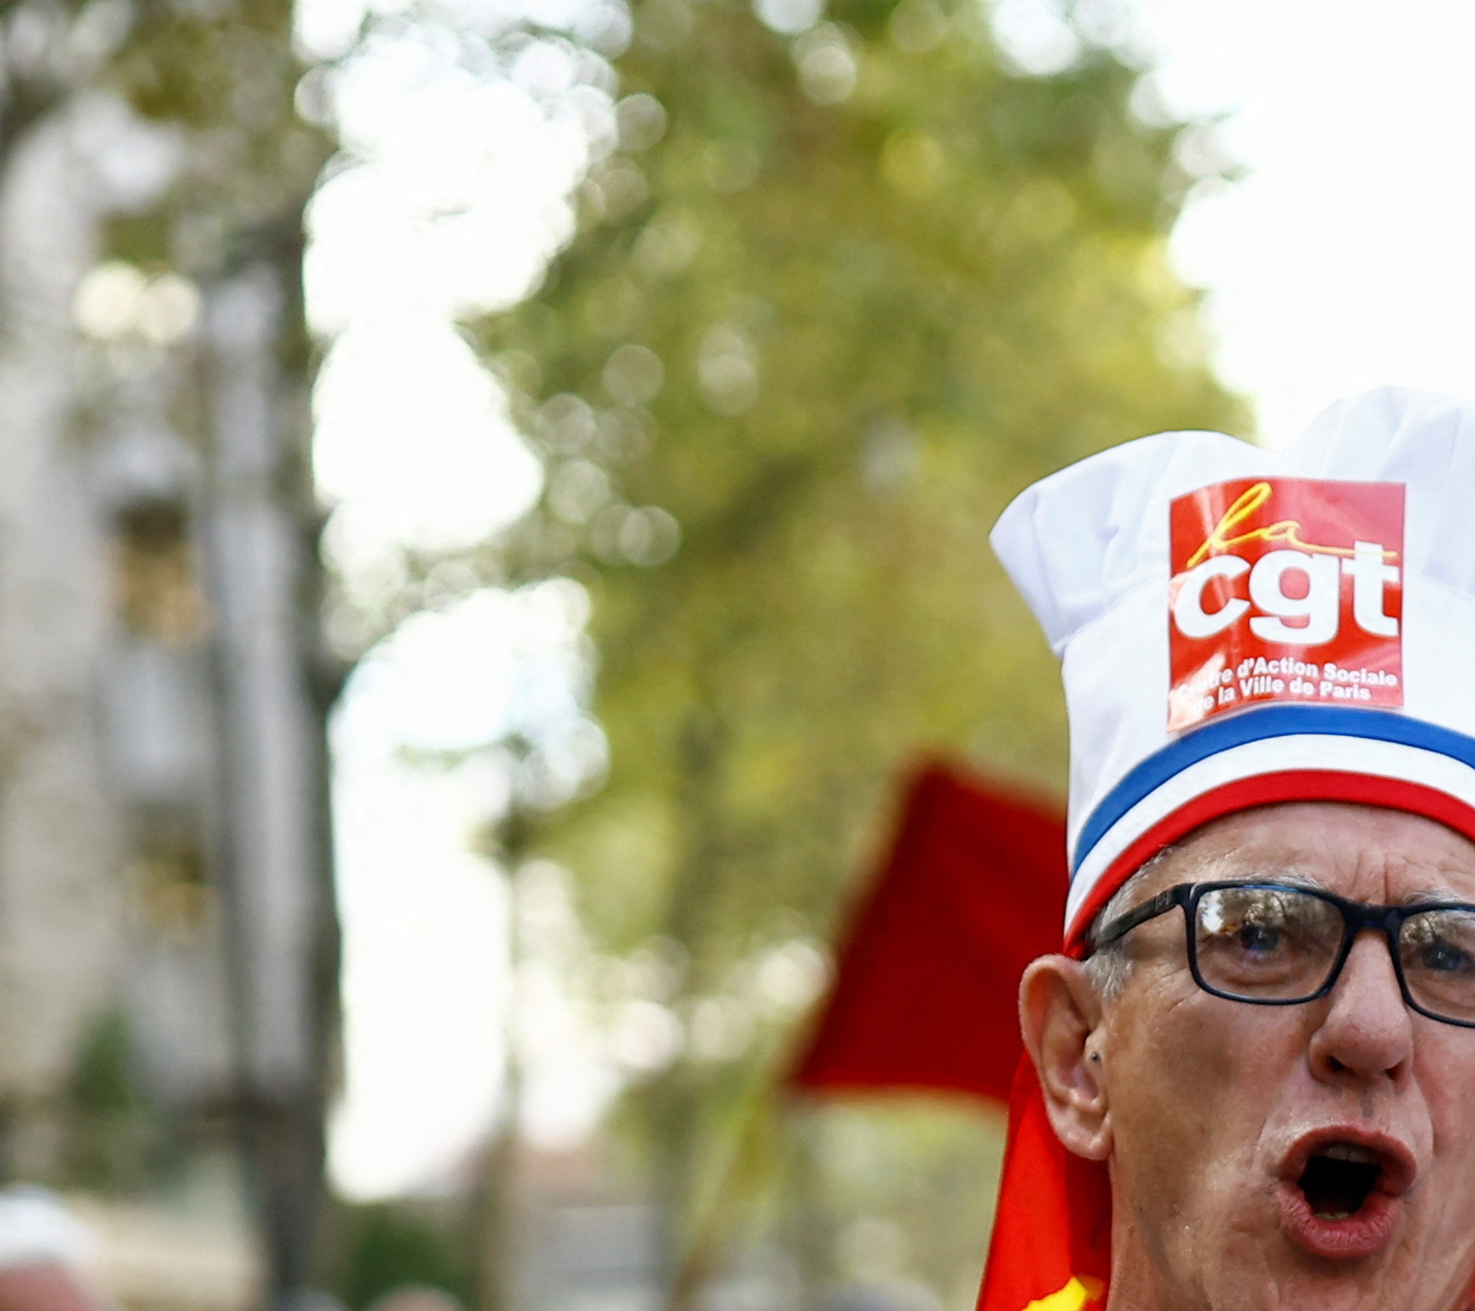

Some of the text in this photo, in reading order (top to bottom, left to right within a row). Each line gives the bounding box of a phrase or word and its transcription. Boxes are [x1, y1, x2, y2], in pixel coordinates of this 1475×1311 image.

[1186, 482, 1398, 567] la
[1173, 541, 1399, 645] cgt
[1218, 686, 1235, 704] la
[1240, 676, 1285, 697] Ville
[1290, 677, 1315, 695] de
[1320, 681, 1371, 700] Paris
[1237, 657, 1318, 678] d'Action
[1324, 663, 1398, 686] Sociale
